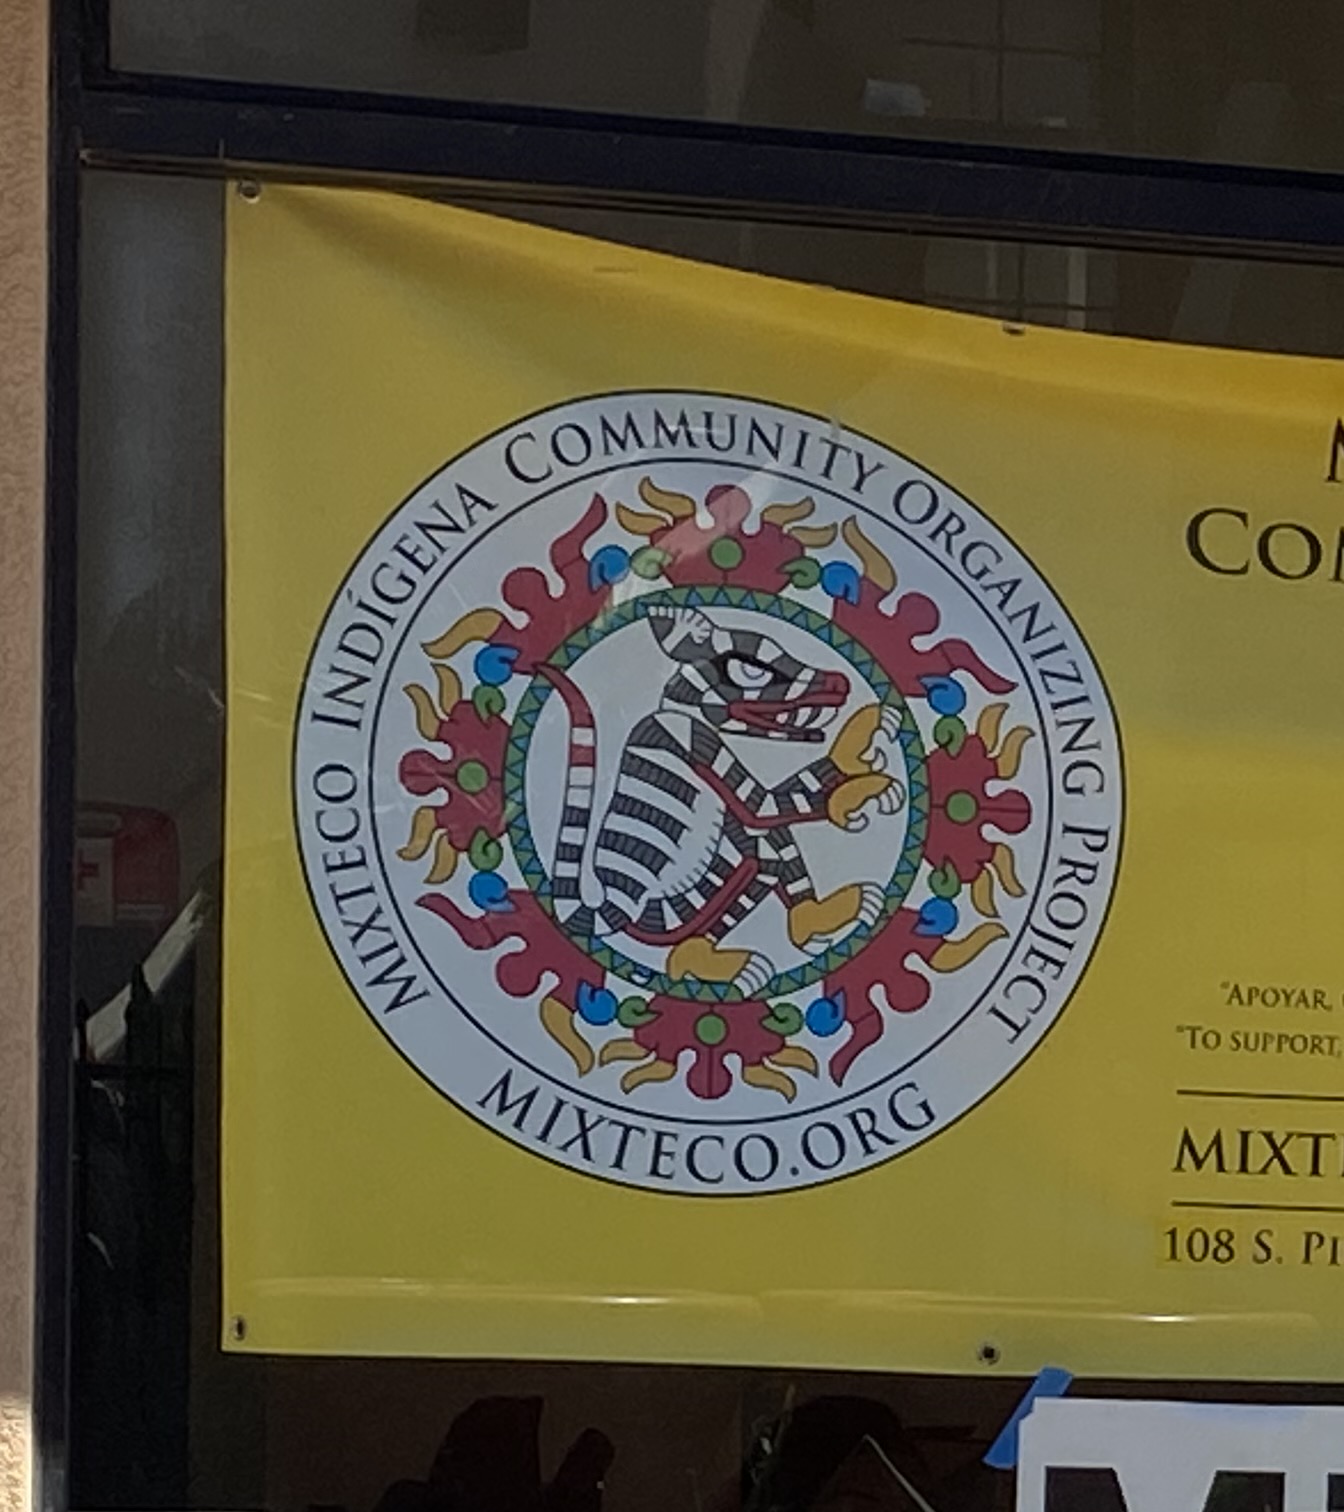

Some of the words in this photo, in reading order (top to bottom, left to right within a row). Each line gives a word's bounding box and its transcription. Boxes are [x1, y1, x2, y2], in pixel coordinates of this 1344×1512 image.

[503, 408, 887, 498] COMMUNITY
[891, 478, 1107, 799] ORGANIZING
[312, 763, 432, 1015] MIXTECO
[987, 822, 1111, 1047] PROJECT
[476, 1067, 938, 1185] MIXTECO.ORG
[1165, 1227, 1235, 1264] 108
[1252, 1229, 1284, 1265] S.
